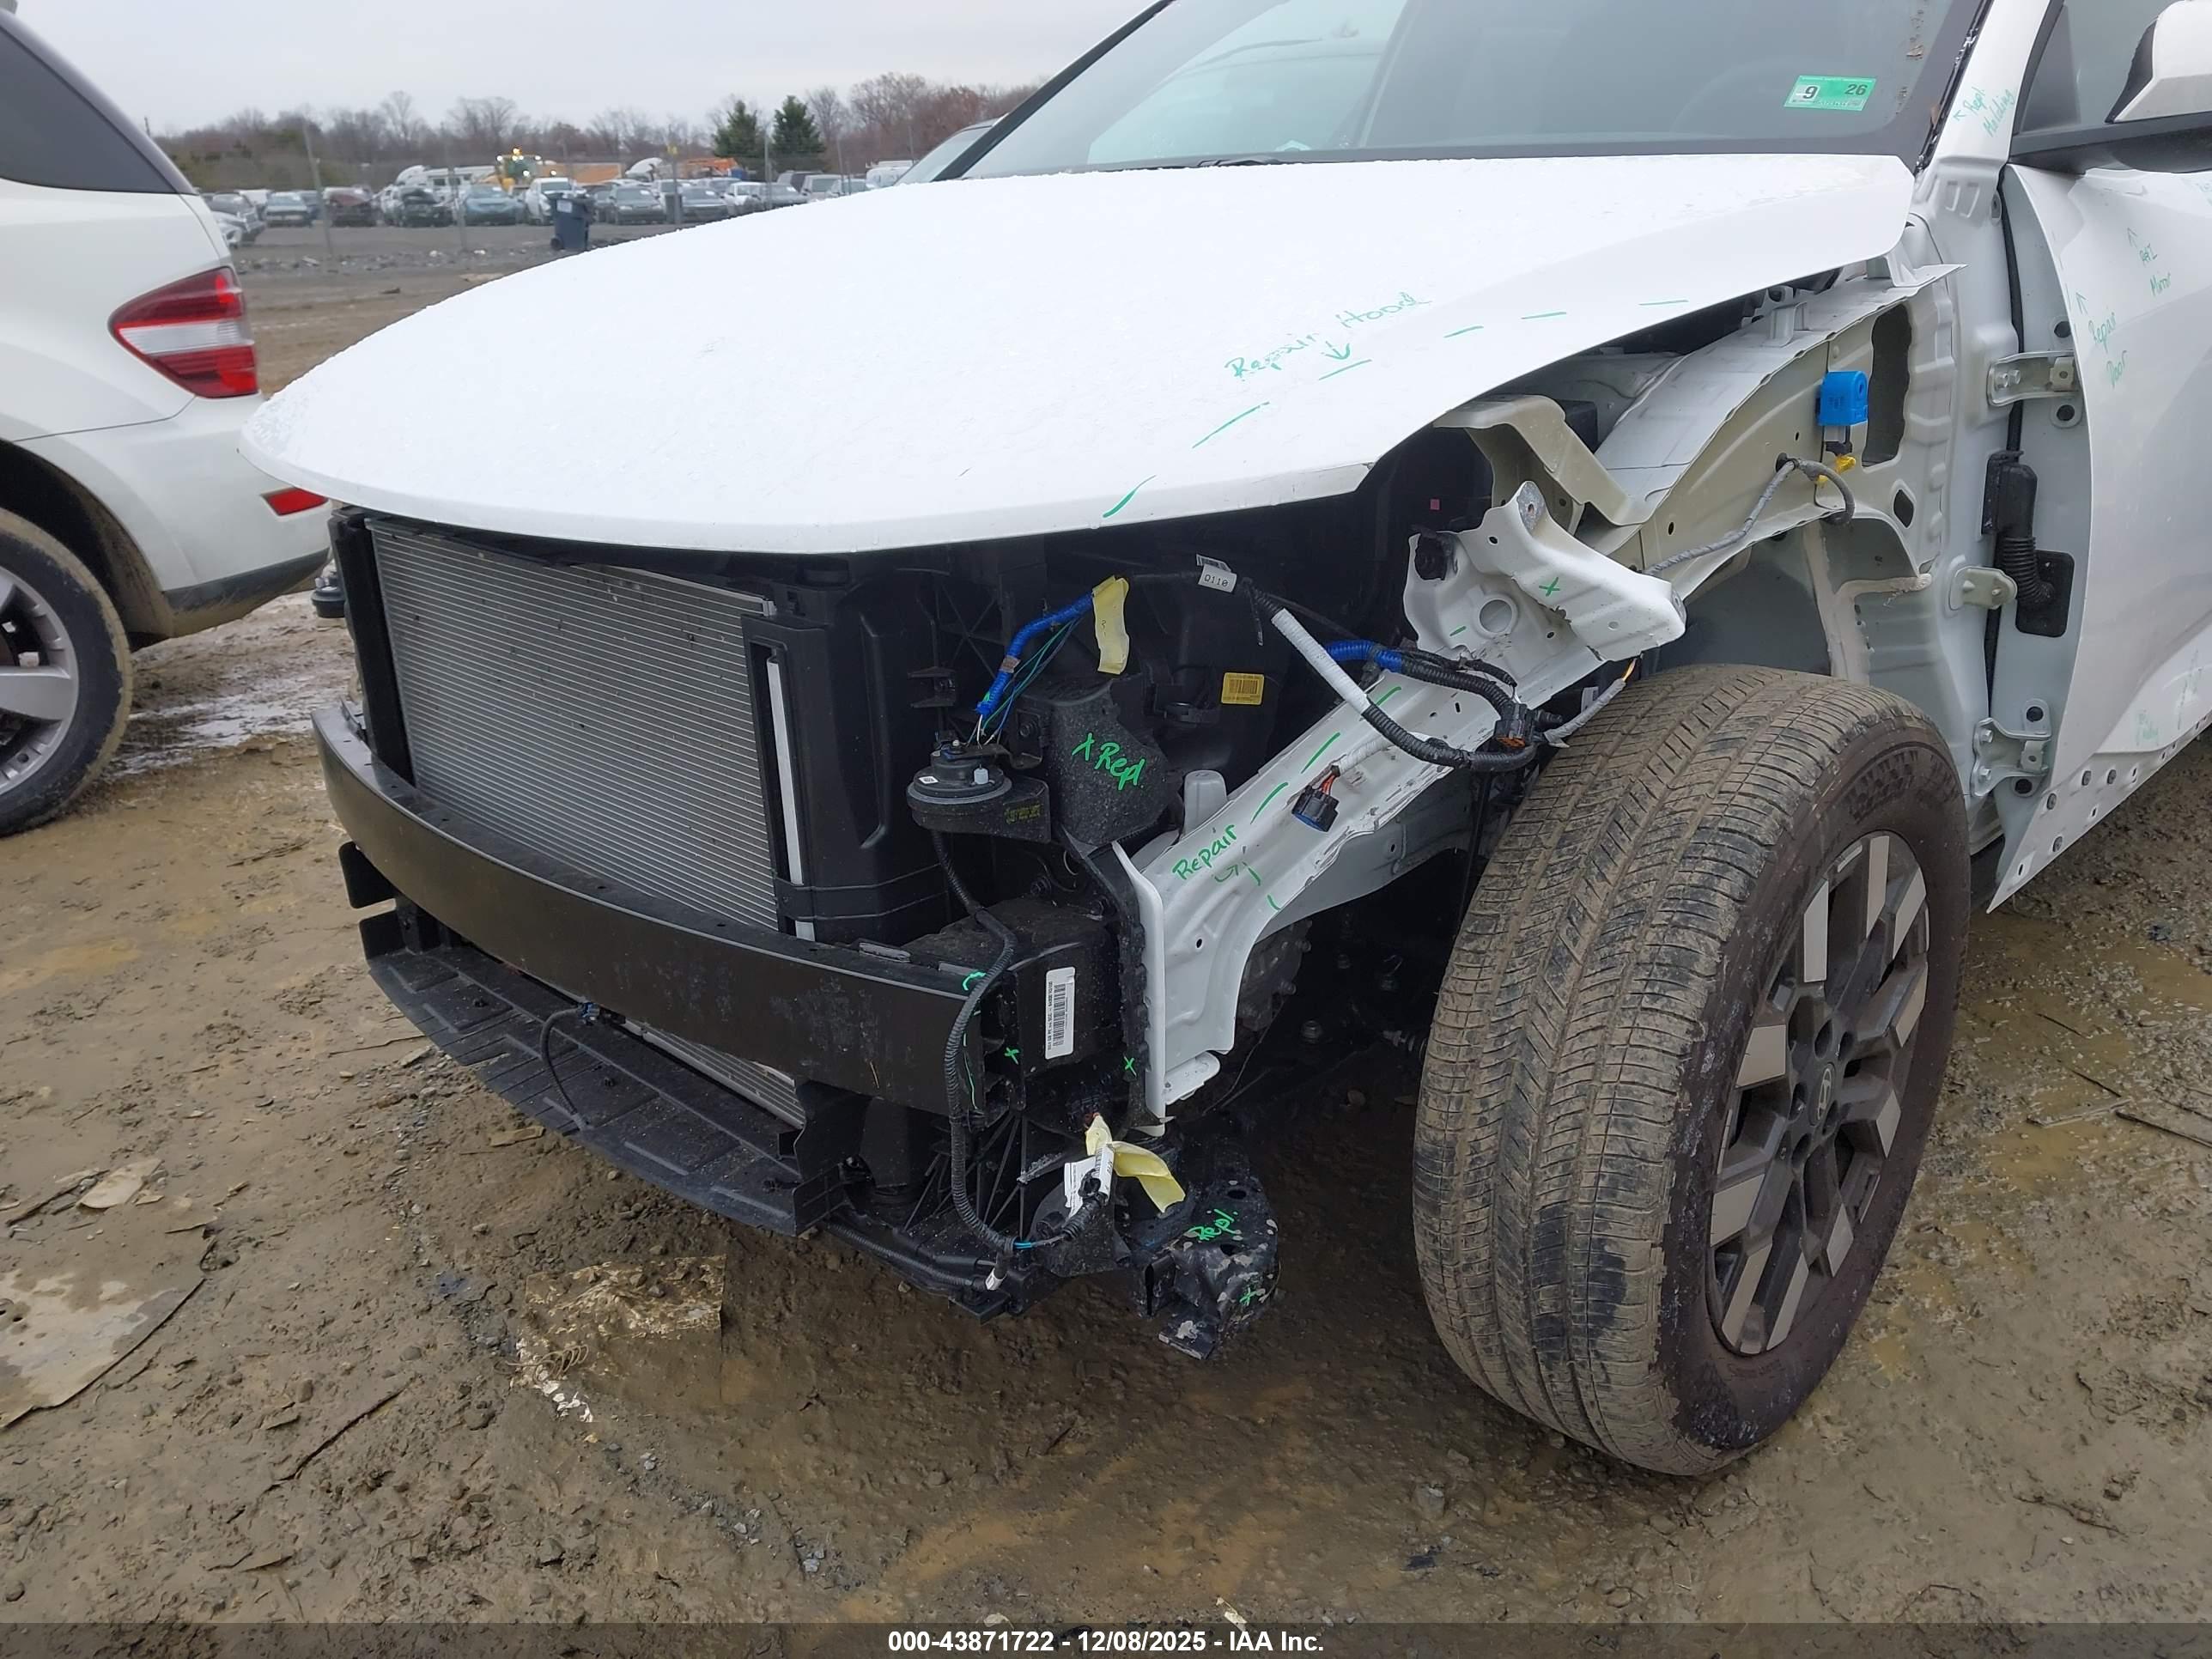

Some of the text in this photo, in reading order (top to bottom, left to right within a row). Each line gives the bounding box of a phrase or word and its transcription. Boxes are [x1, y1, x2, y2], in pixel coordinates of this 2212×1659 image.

[1803, 83, 1869, 100] 9 26
[1335, 291, 1433, 328] Hood
[1172, 824, 1237, 880] Repair
